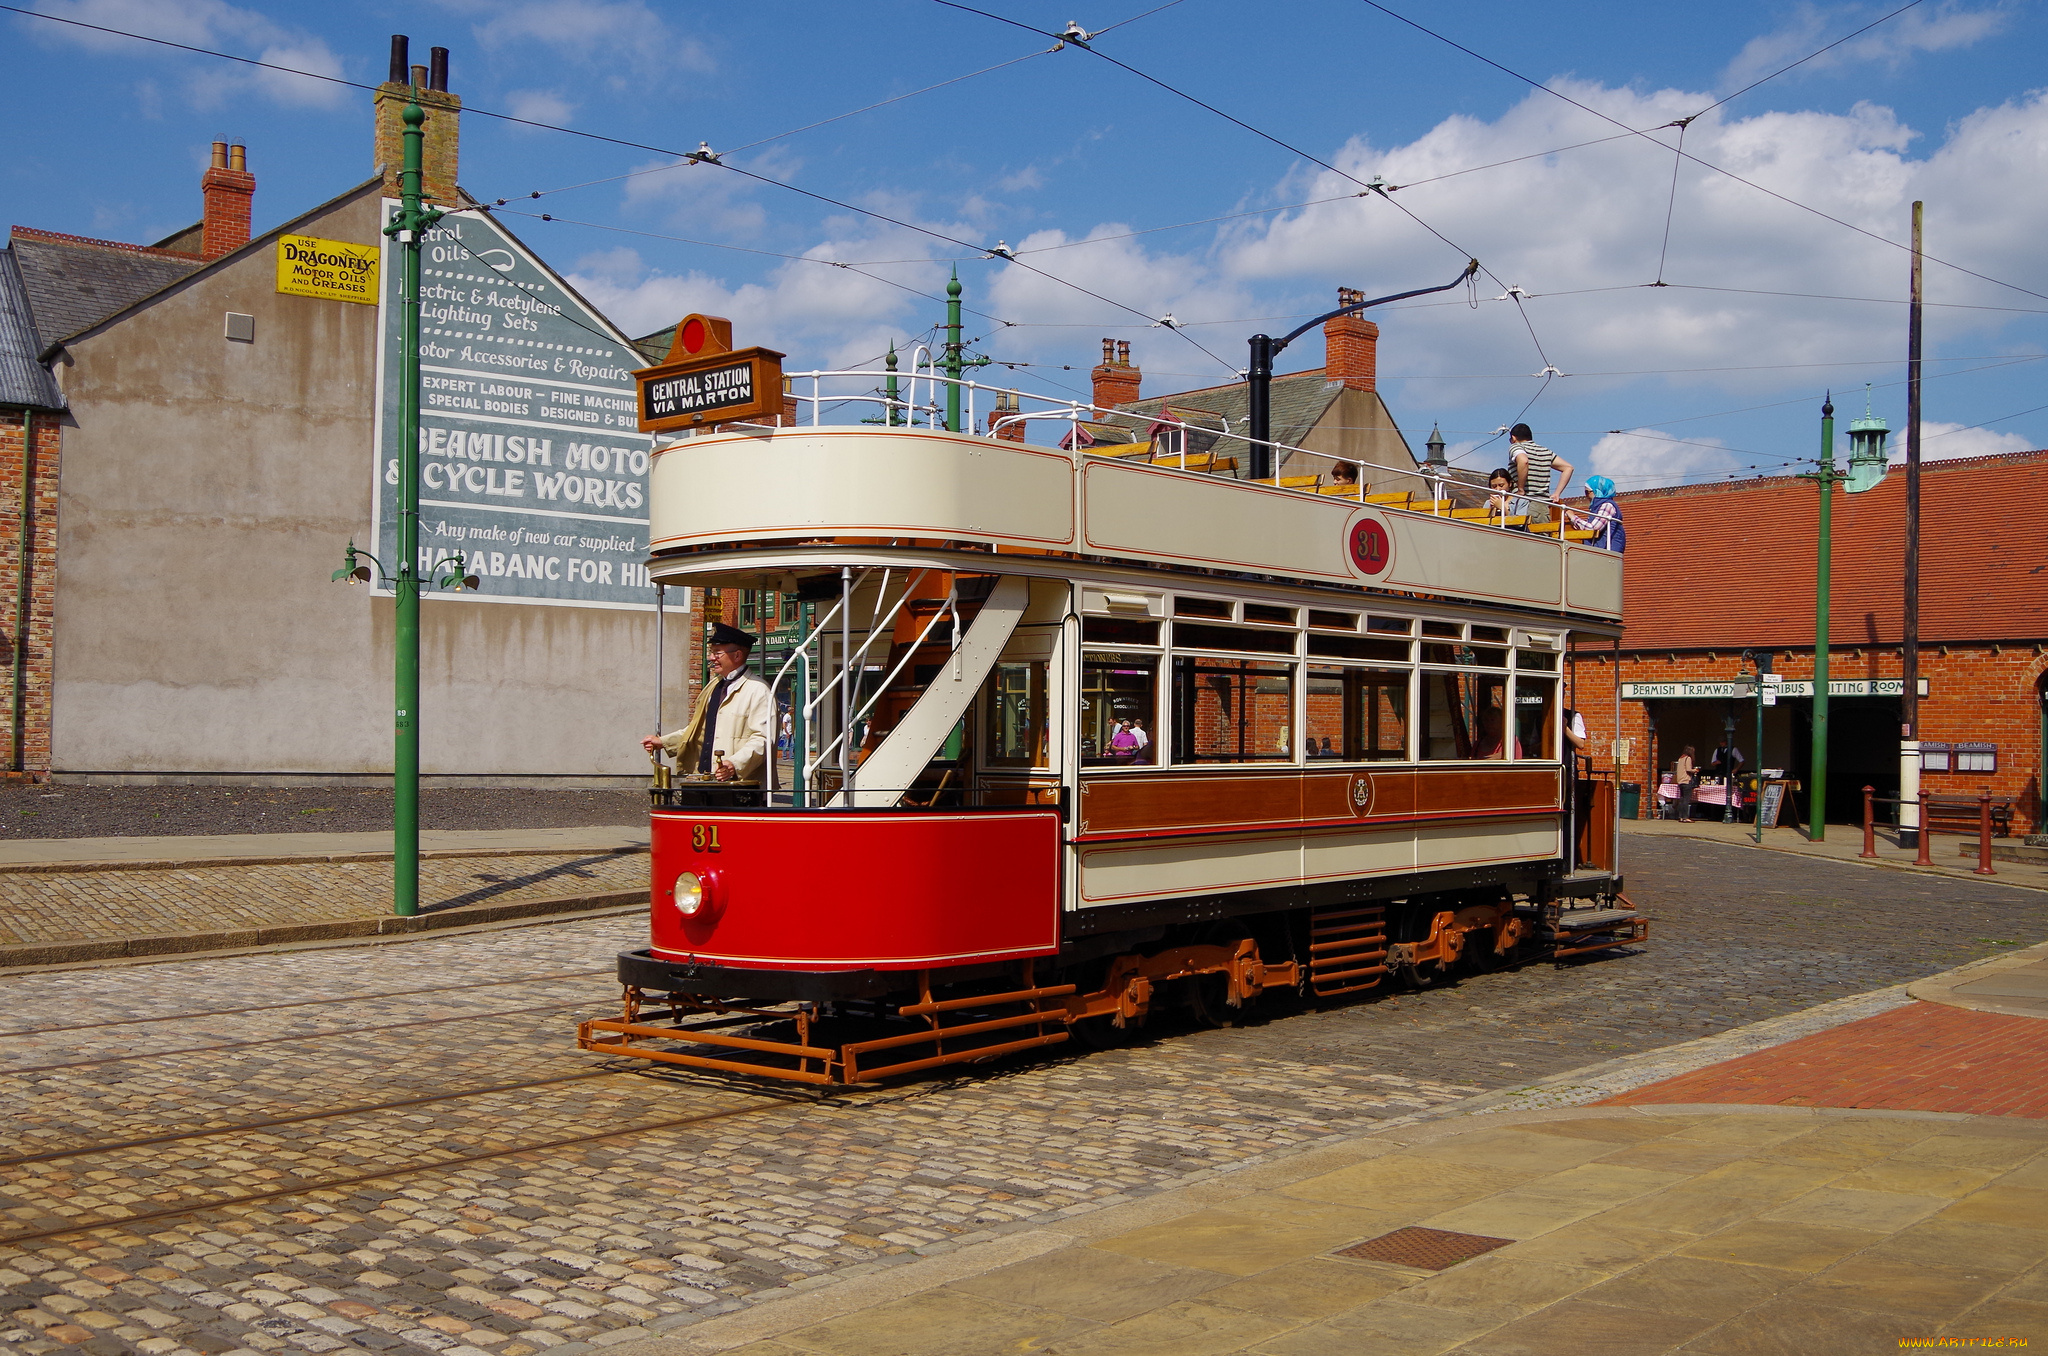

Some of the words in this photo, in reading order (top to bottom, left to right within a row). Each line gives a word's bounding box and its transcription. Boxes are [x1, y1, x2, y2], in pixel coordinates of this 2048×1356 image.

[298, 240, 316, 248] USE
[420, 224, 463, 243] etrol
[432, 244, 470, 262] Oils
[293, 265, 334, 279] MOTOR
[339, 271, 366, 284] OILS
[312, 278, 366, 293] GREASES
[420, 302, 492, 330] Lighting
[502, 312, 538, 332] Sets
[470, 288, 484, 304] &
[486, 291, 561, 316] Acetylene
[420, 342, 455, 358] otor
[460, 346, 548, 371] Accessories
[554, 357, 566, 372] &
[569, 358, 629, 382] Repairs
[423, 376, 475, 392] EXPERT
[480, 383, 532, 400] LABOUR
[551, 391, 581, 405] FINE
[584, 395, 638, 413] MACHINE
[653, 376, 701, 401] CENTRAL
[705, 366, 750, 391] STATION
[428, 393, 481, 409] SPECIAL
[484, 400, 529, 415] BODIES
[540, 406, 599, 423] DESIGNED
[604, 414, 614, 425] &
[618, 416, 638, 428] BUI
[653, 401, 675, 414] VIA
[682, 386, 751, 409] MARTON
[565, 442, 650, 476] MOTO
[423, 462, 525, 498] CYCLE
[533, 470, 643, 510] WORKS
[435, 520, 466, 541] Any
[469, 524, 506, 541] make
[508, 526, 526, 546] of
[525, 531, 550, 544] new
[554, 534, 577, 547] car
[578, 535, 635, 553] supplied
[1358, 530, 1380, 560] 31
[419, 546, 560, 581] HARABANC
[568, 557, 612, 585] FOR
[621, 563, 671, 589] HI
[1633, 685, 1675, 695] BEAMISH
[692, 824, 721, 851] 31
